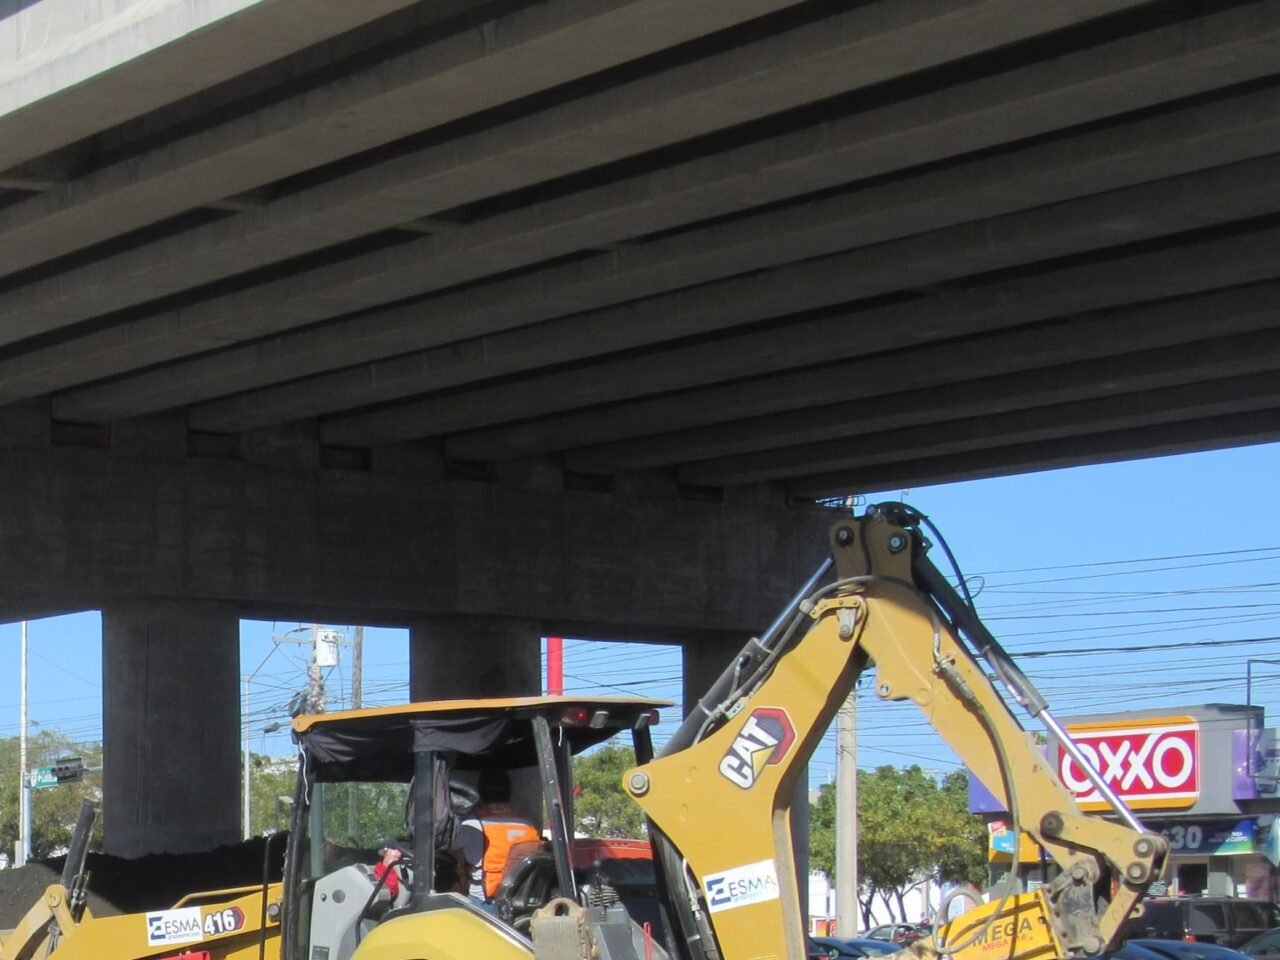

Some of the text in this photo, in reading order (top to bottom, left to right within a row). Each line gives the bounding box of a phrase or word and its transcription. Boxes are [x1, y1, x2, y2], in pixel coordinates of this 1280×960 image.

[719, 716, 779, 789] CAT
[1062, 735, 1193, 793] OXXO
[728, 875, 776, 898] ESMA
[165, 917, 200, 935] ESMA
[204, 909, 236, 935] 416
[972, 917, 1033, 947] MEGA
